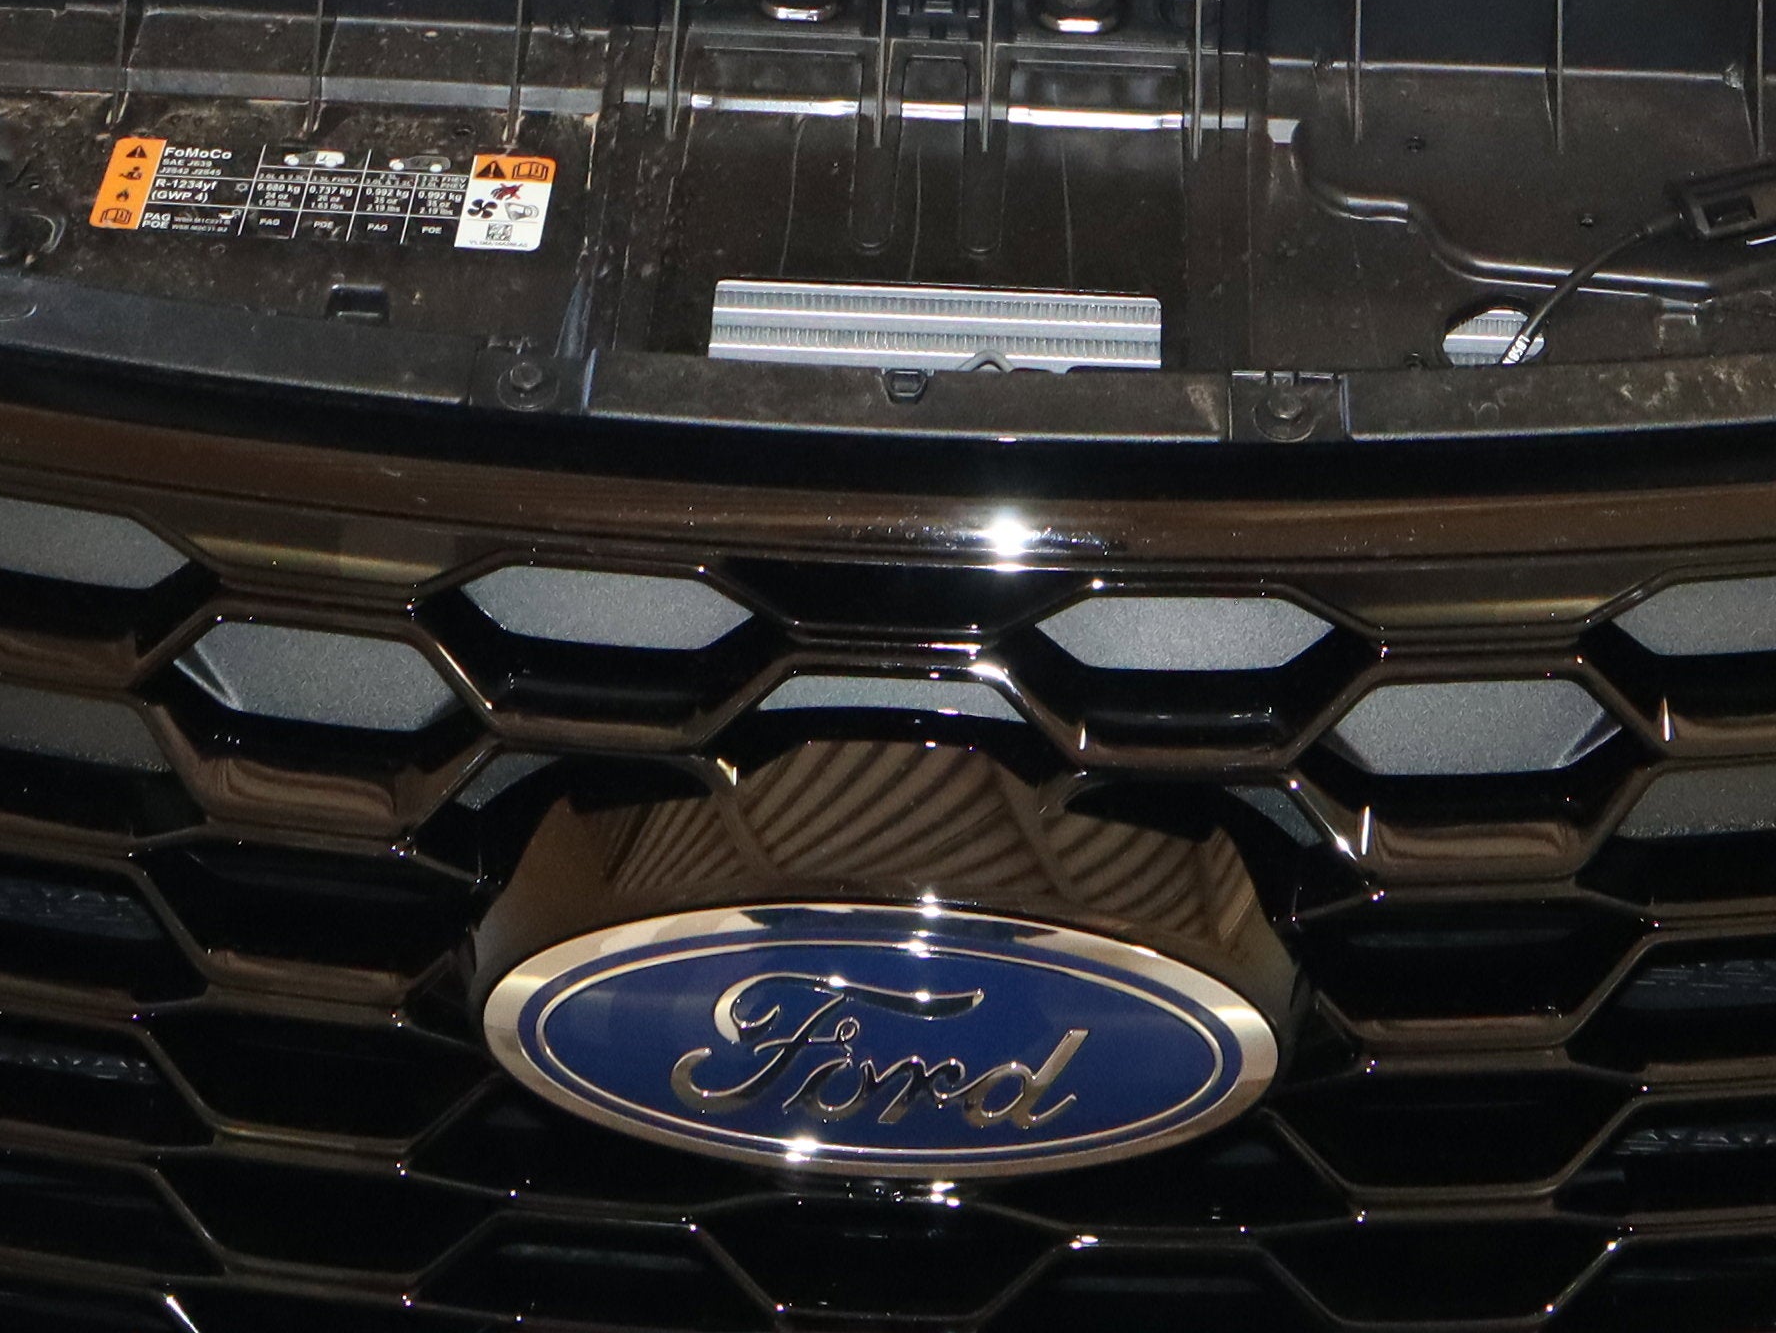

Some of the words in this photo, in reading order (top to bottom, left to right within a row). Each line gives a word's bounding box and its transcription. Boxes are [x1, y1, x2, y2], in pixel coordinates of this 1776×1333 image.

[164, 146, 233, 160] FoMoCo
[161, 158, 185, 166] SAE
[155, 178, 219, 192] R-1234yf
[287, 184, 301, 195] kg
[309, 185, 338, 194] 0.737
[339, 187, 353, 197] kg
[396, 189, 410, 199] kg
[151, 190, 193, 201] (GWP
[195, 192, 209, 204] 4)
[448, 192, 463, 203] kg
[144, 212, 172, 221] PAG
[142, 220, 170, 229] POE
[259, 218, 281, 226] PAG
[313, 220, 335, 229] POE
[367, 223, 389, 232] PAG
[421, 225, 443, 234] POE
[670, 971, 1092, 1131] Ford
